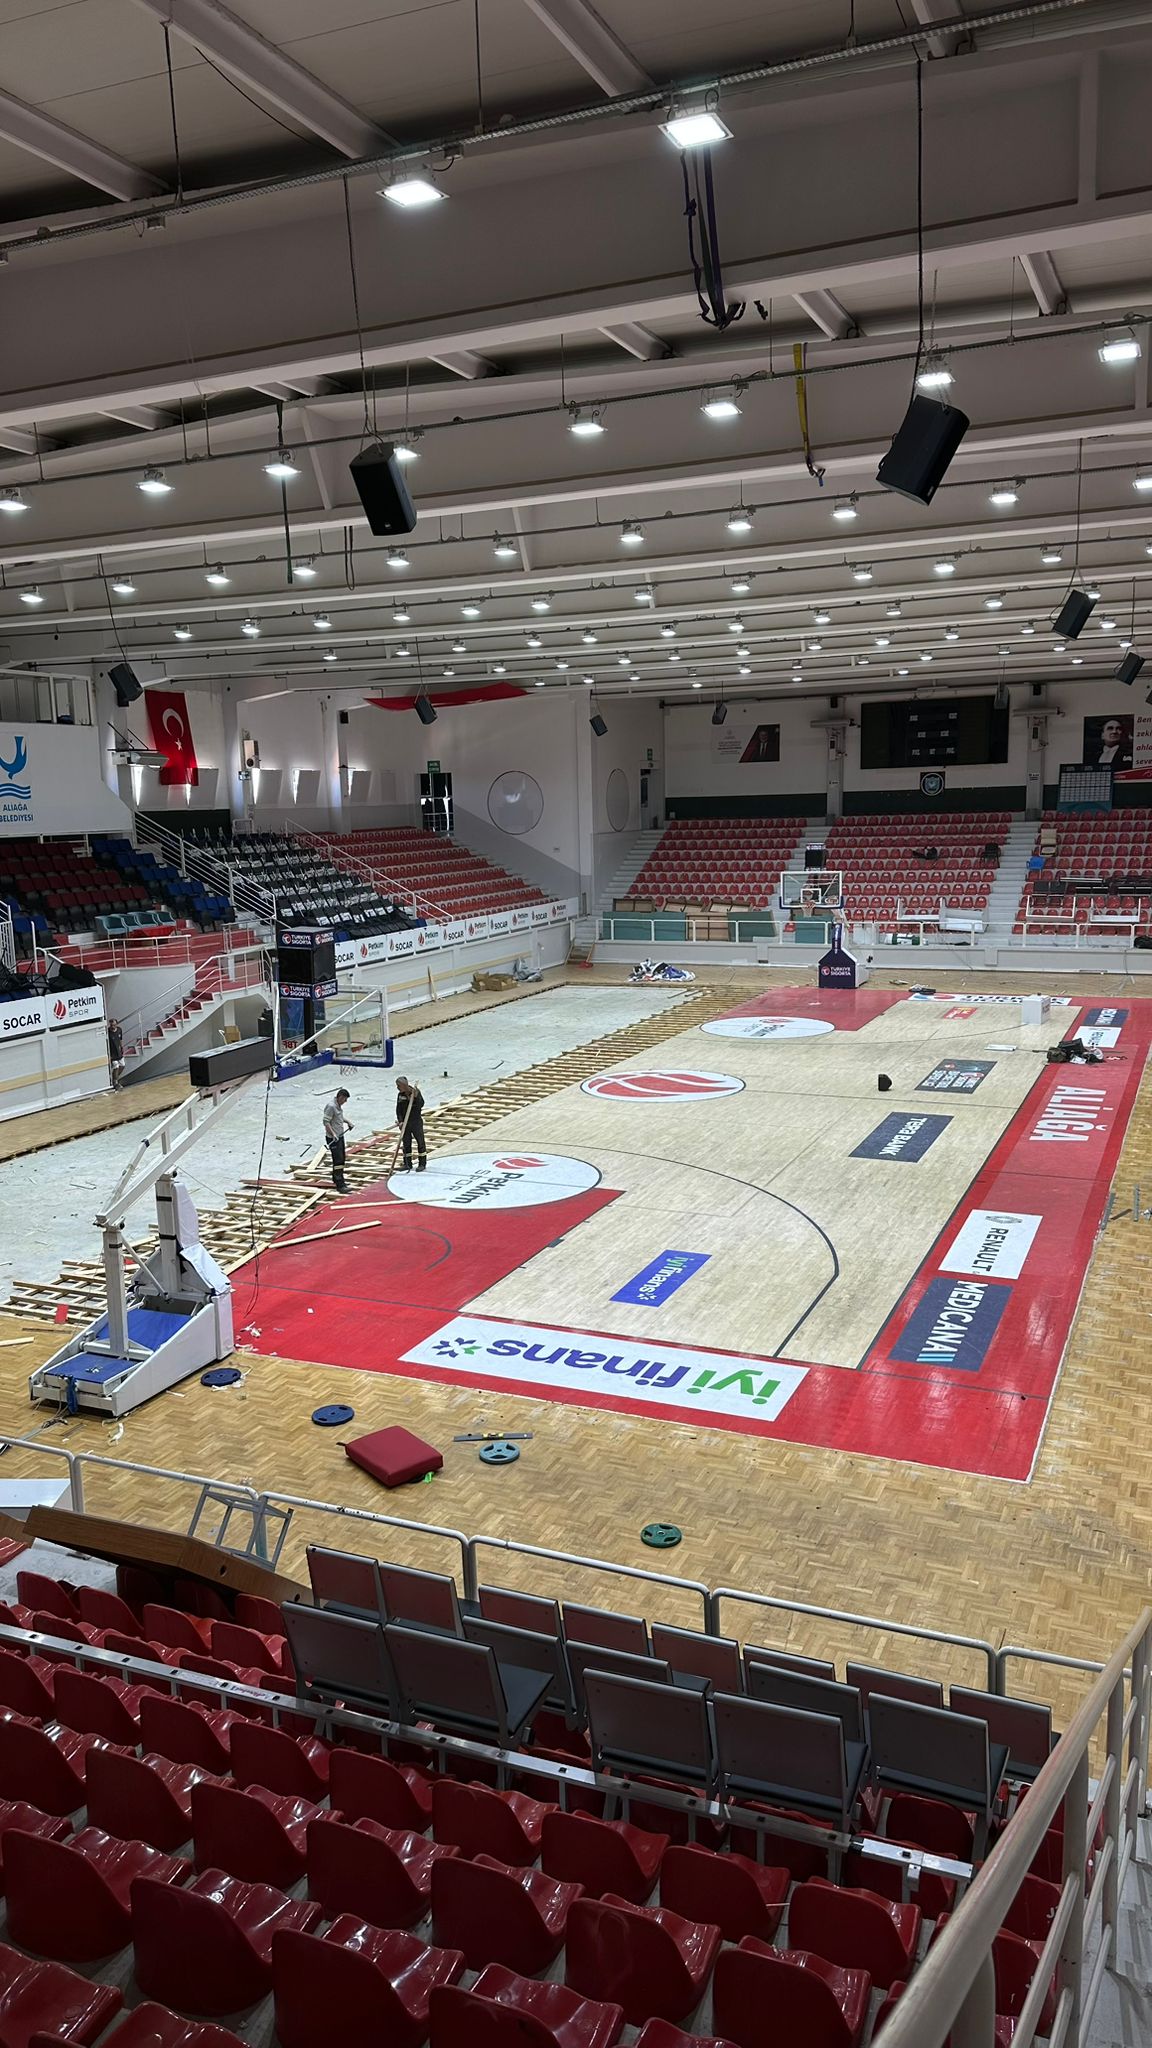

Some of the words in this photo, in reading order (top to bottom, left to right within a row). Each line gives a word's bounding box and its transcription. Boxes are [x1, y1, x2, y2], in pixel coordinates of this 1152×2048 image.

[448, 930, 464, 940] SOCAR
[395, 940, 413, 952] SOCAR
[68, 996, 97, 1009] Petkim
[3, 1013, 42, 1030] SOCAR
[68, 1009, 89, 1018] SPOR
[1029, 1085, 1114, 1142] ALİAĞA
[449, 1171, 525, 1204] Petkim
[971, 1227, 1010, 1272] RENAULT
[921, 1280, 989, 1352] MEDICANA
